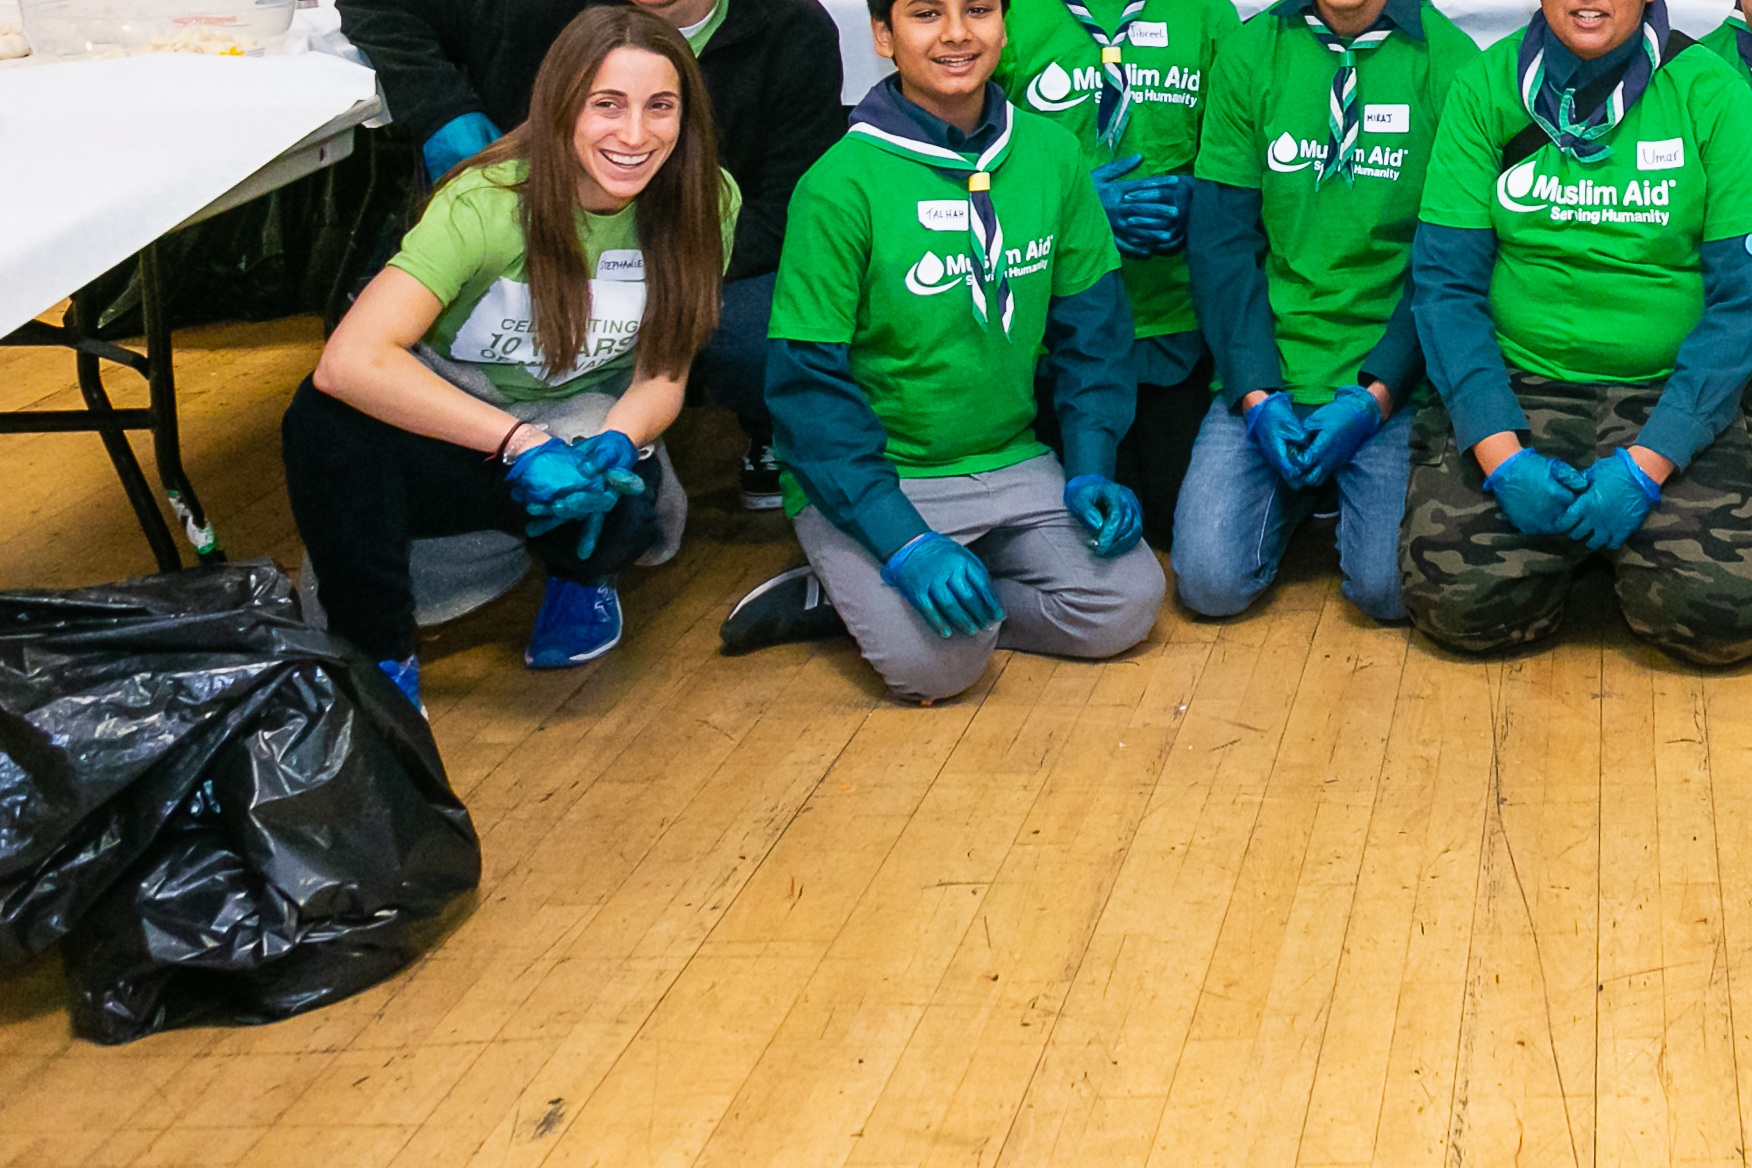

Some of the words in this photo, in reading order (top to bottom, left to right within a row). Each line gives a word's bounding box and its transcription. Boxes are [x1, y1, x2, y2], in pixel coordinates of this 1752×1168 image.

[1073, 63, 1160, 91] Mulim
[1164, 65, 1200, 92] Aid
[1144, 89, 1198, 108] Humanity
[1368, 145, 1403, 168] Aid
[1642, 148, 1680, 165] Umar
[1353, 164, 1400, 181] Humanity
[1532, 174, 1617, 206] Muslim
[1622, 179, 1670, 206] Aid
[926, 207, 965, 220] TALHAH
[1601, 208, 1670, 227] Humanity
[1025, 235, 1052, 262] Aid
[1008, 259, 1049, 279] Humanity
[489, 332, 522, 356] 10
